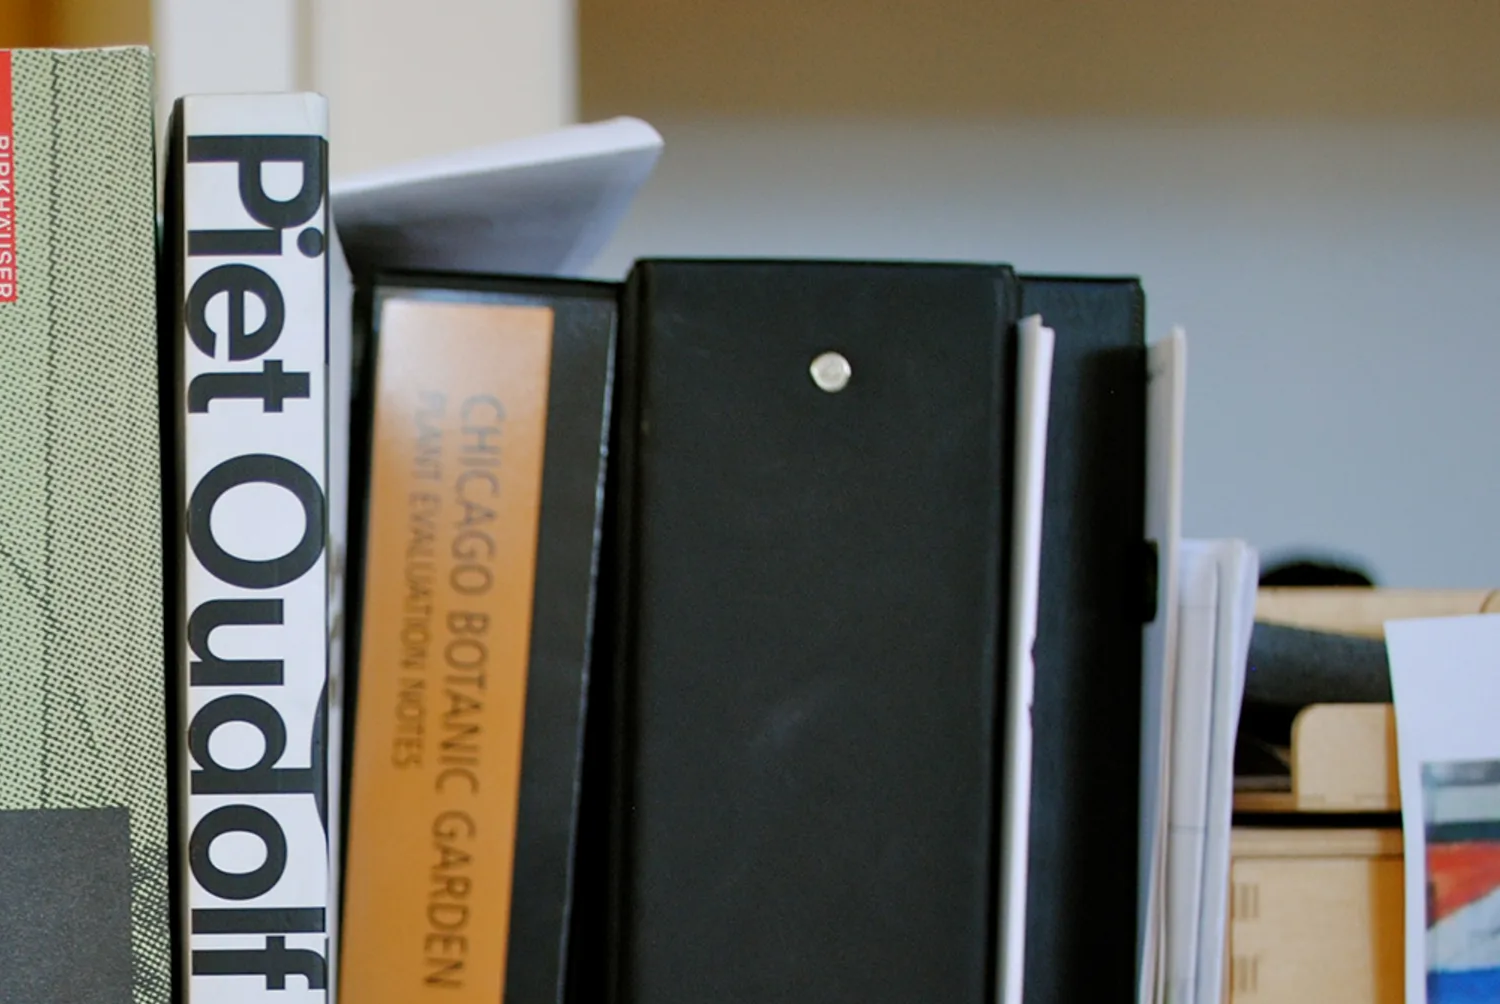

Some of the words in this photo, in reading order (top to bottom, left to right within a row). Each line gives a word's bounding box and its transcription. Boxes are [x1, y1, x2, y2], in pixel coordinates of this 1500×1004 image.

[186, 134, 328, 414] Piet
[411, 392, 446, 480] PLANT
[450, 395, 504, 597] CHICAGO
[399, 489, 442, 669] EVALUATION
[187, 453, 329, 990] Oudolf
[391, 678, 426, 770] NOTES
[435, 609, 490, 794] BOTANIC
[424, 809, 476, 991] GARDEN
